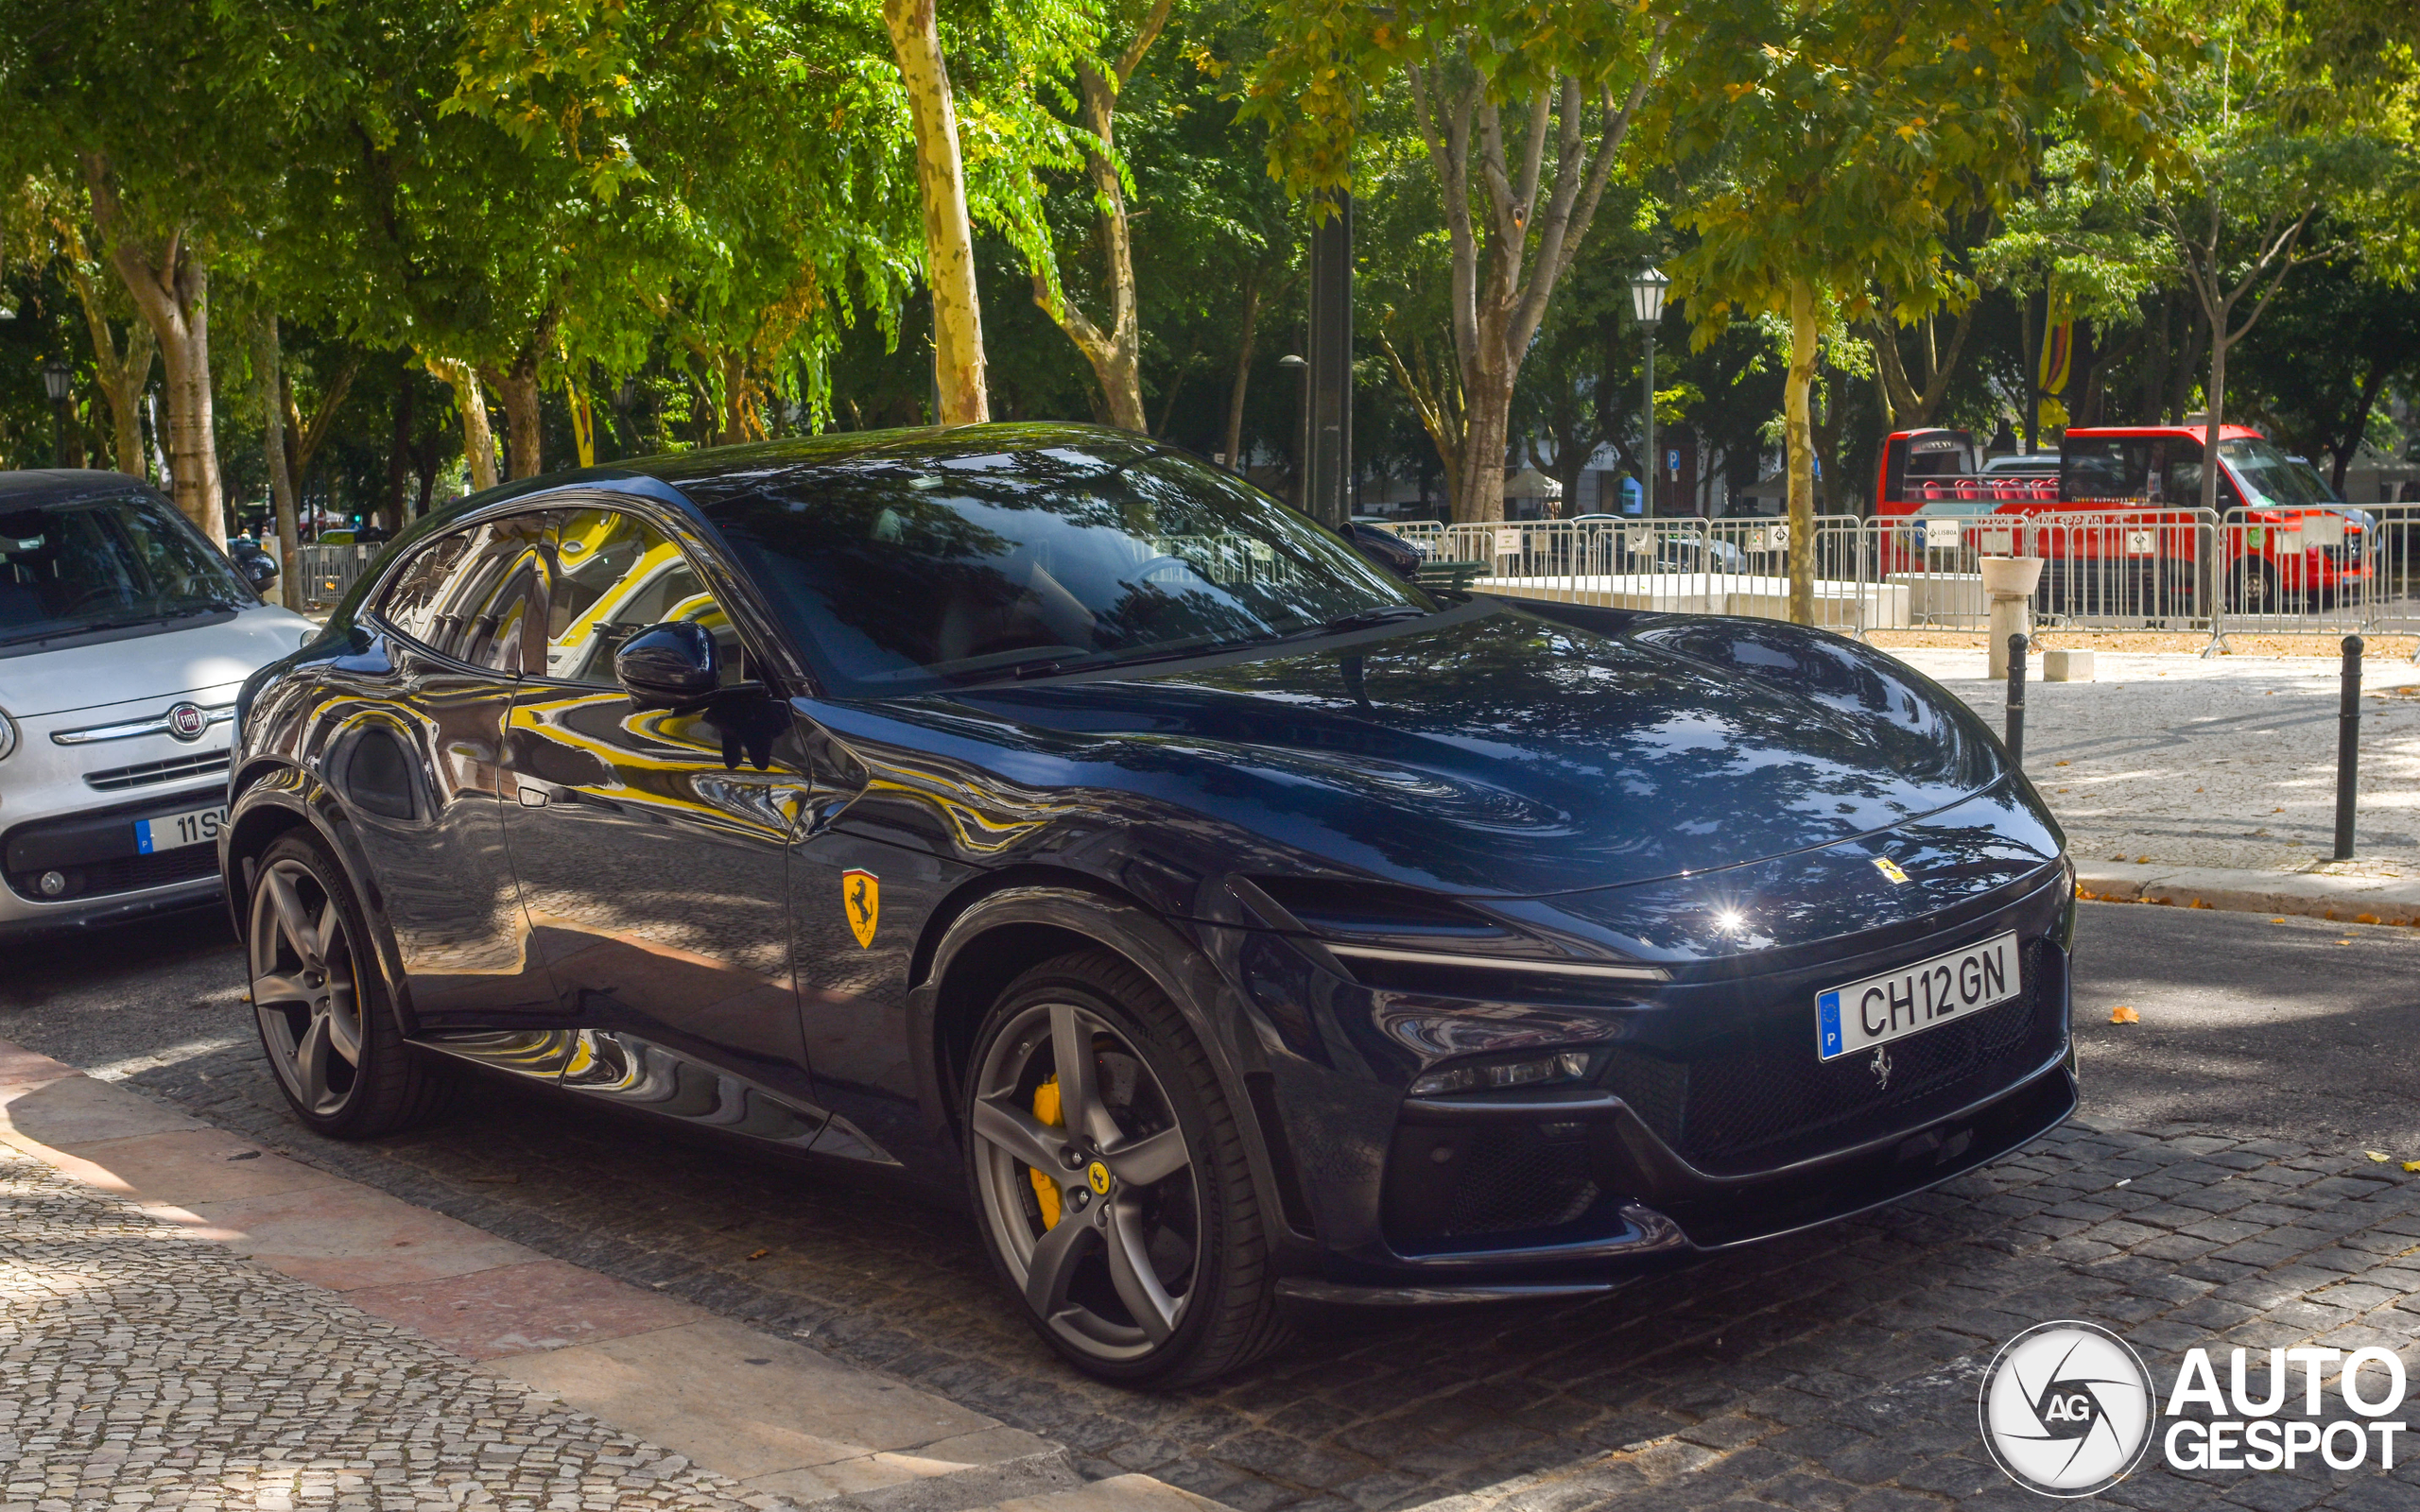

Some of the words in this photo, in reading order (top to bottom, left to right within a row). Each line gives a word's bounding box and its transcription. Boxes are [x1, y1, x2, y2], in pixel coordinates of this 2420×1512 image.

[1669, 452, 1678, 468] P
[180, 713, 198, 728] FIAT
[141, 840, 148, 849] P
[1827, 1032, 1836, 1047] P
